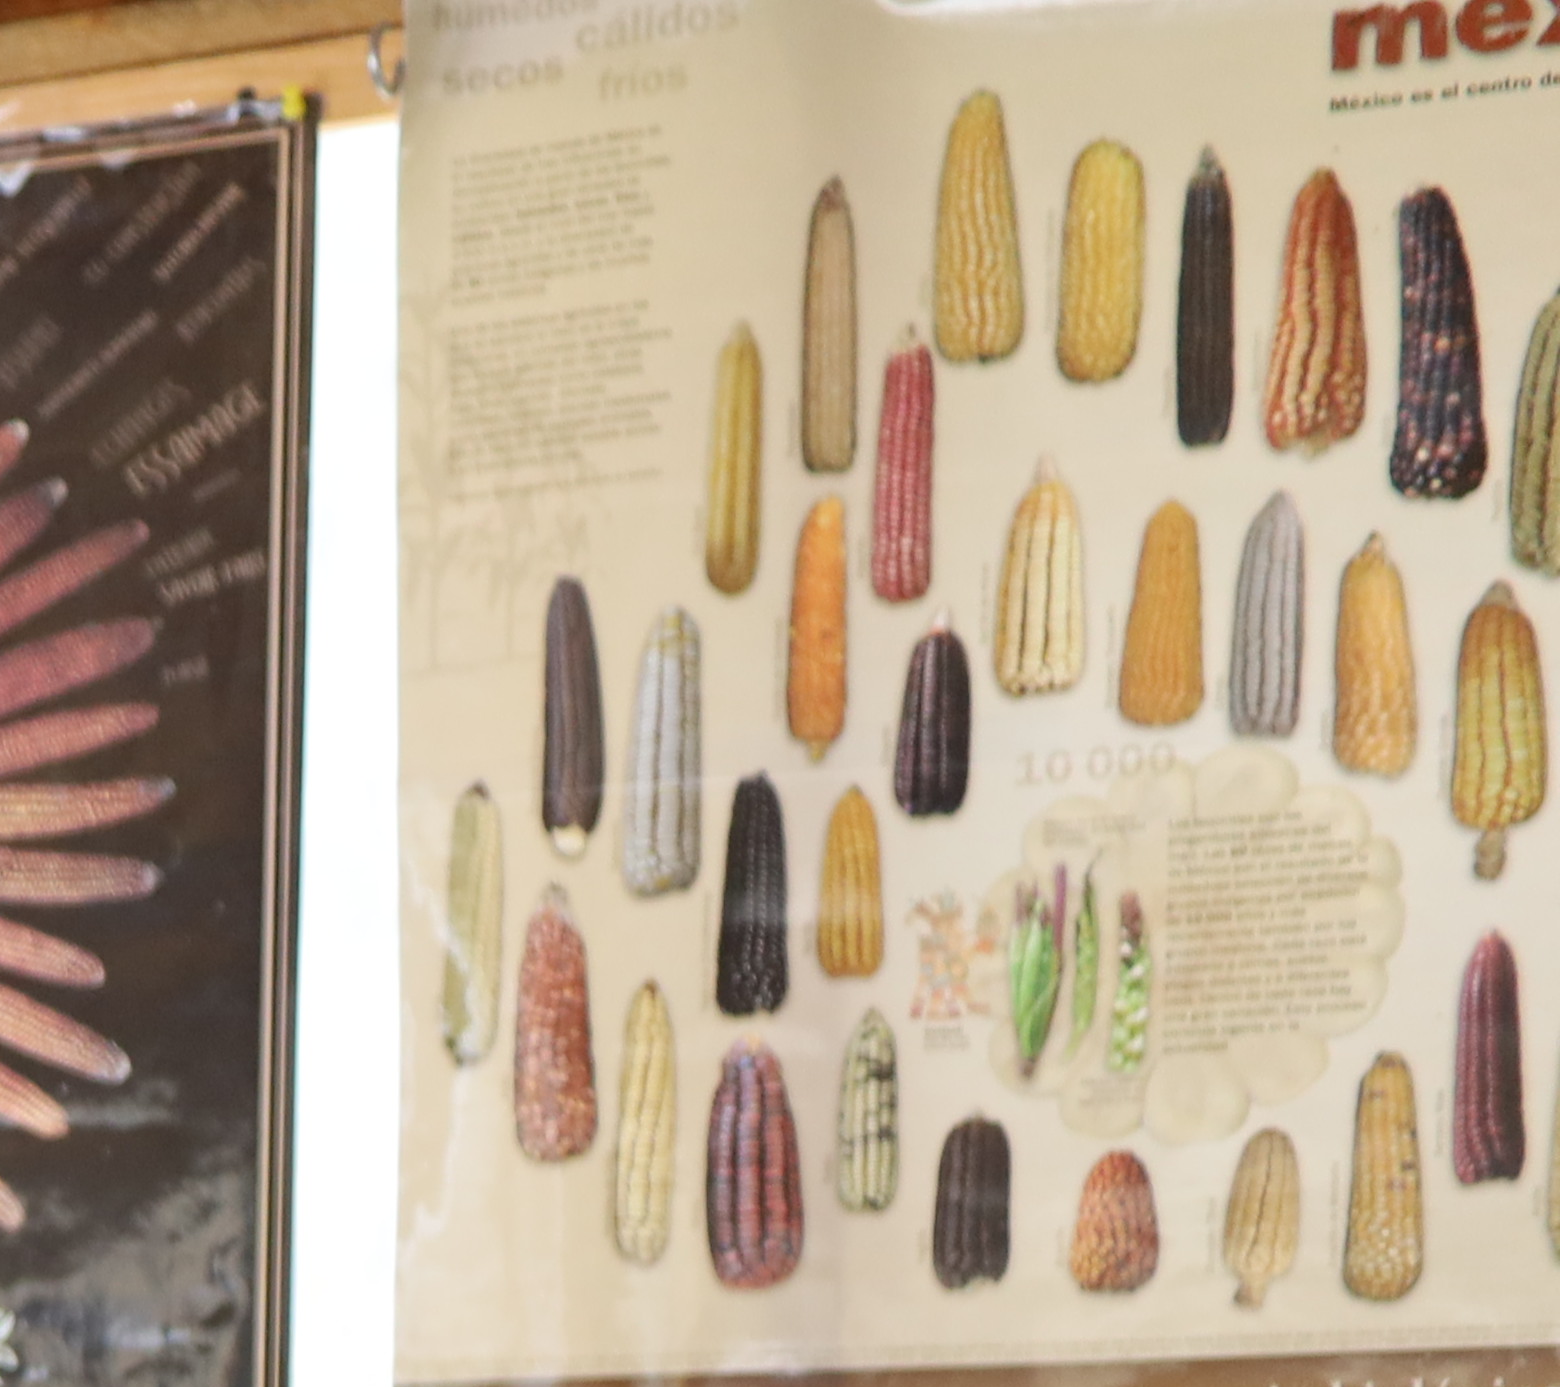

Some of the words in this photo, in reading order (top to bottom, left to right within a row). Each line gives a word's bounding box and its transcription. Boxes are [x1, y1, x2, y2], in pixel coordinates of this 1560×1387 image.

[442, 56, 563, 97] secos
[1466, 76, 1532, 95] centro
[1014, 749, 1072, 788] 10
[1086, 742, 1176, 780] 000
